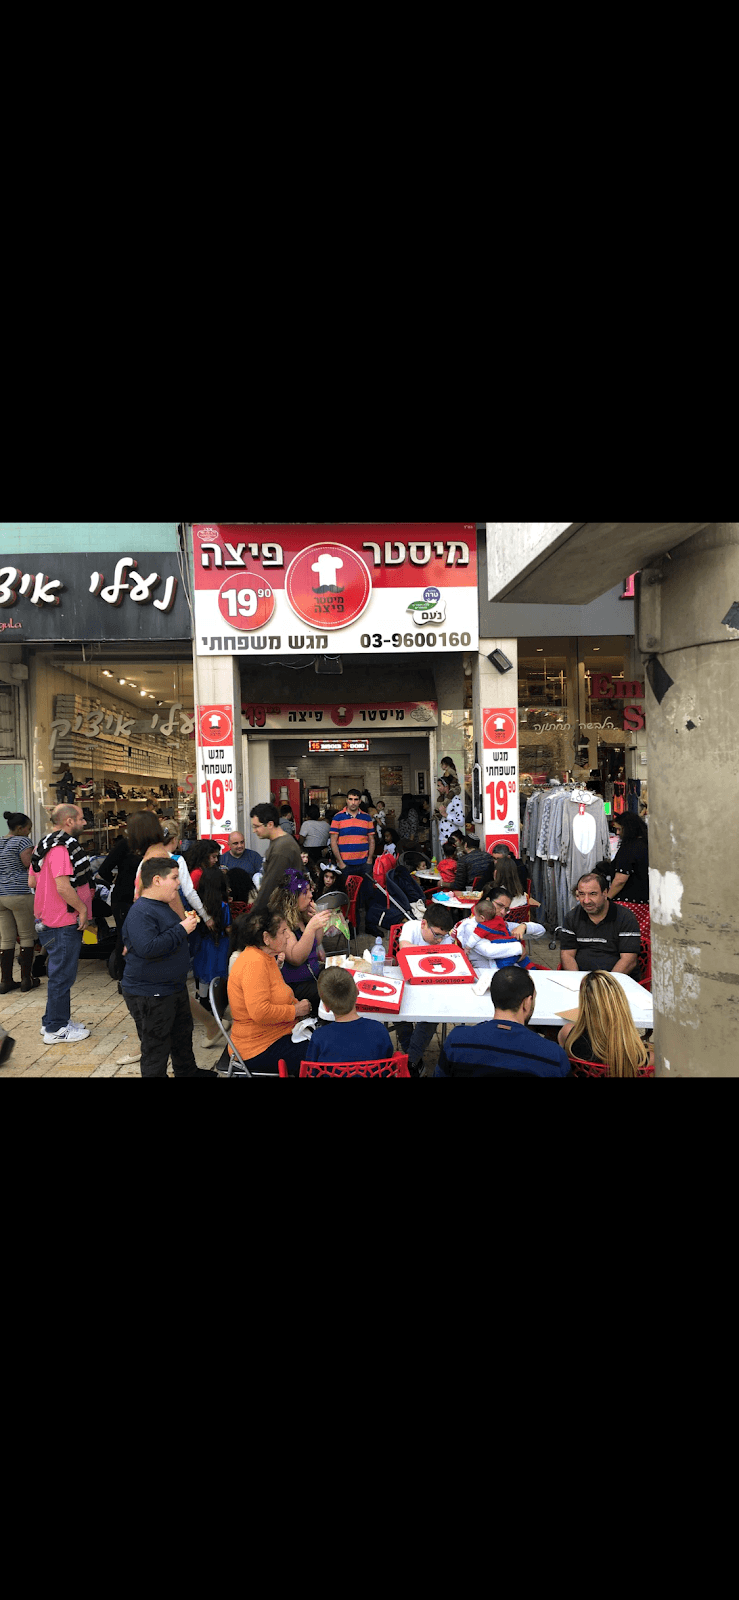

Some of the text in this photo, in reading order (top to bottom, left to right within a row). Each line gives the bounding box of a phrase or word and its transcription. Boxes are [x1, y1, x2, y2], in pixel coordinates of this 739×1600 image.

[200, 540, 470, 568] מיסטר פיצה
[89, 557, 178, 613] נעלי
[221, 588, 271, 617] 19 90
[313, 596, 344, 604] מיסטר
[314, 604, 345, 613] פיצה
[201, 634, 329, 651] מגש משפחתי
[360, 631, 472, 649] 03-9600160
[588, 673, 646, 699] Em
[288, 710, 323, 722] פיצה
[359, 709, 405, 721] מיסטר
[622, 704, 646, 731] S
[48, 710, 136, 751] איציק
[208, 749, 225, 760] מגש
[492, 751, 509, 762] מגש
[201, 763, 233, 775] משפחתי
[486, 765, 516, 776] משפחתי
[201, 778, 233, 820] 19 90
[486, 780, 516, 821] 19 90
